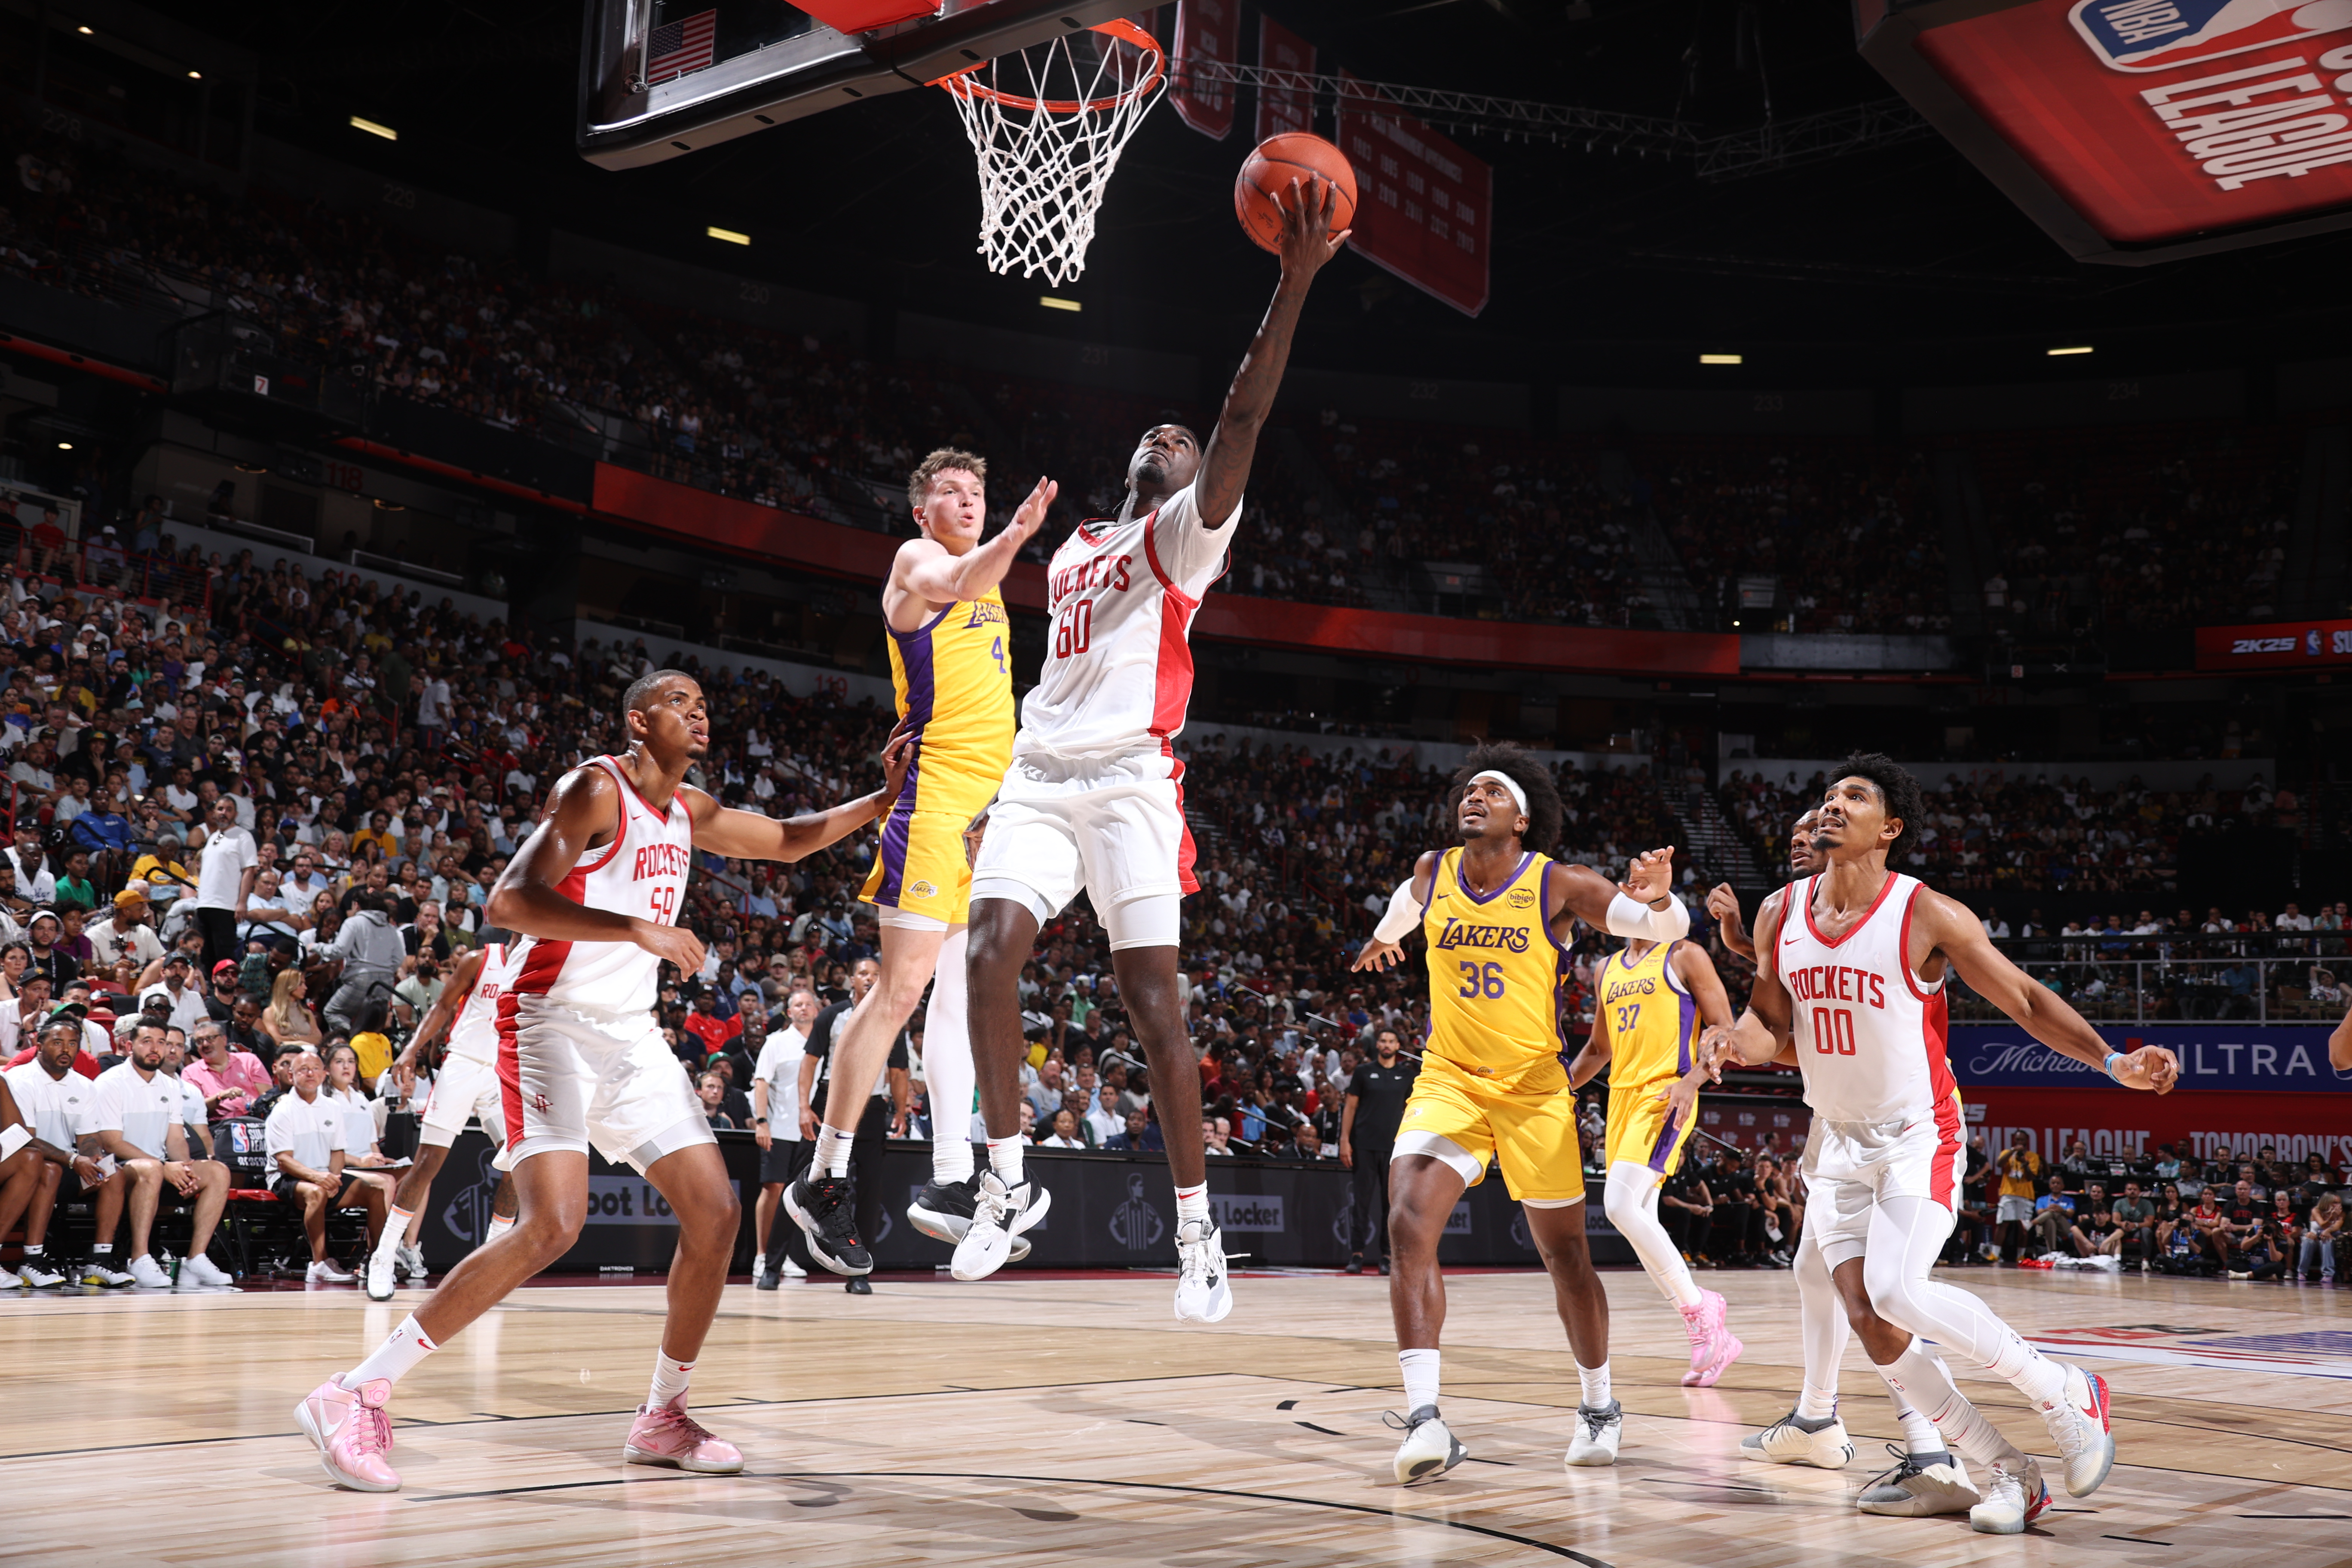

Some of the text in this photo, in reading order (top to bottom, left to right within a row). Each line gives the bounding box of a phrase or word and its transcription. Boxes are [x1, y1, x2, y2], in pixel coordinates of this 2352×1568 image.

[2100, 0, 2189, 44] NBA
[42, 107, 82, 141] 228
[2139, 56, 2352, 191] LEAGUE
[382, 183, 416, 209] 229
[739, 282, 769, 305] 230
[1082, 346, 1109, 365] 231
[257, 378, 266, 392] 7
[1410, 381, 1439, 400] 232
[2107, 382, 2140, 401] 234
[1753, 394, 1784, 412] 233
[327, 462, 364, 491] 118
[1056, 599, 1093, 659] 60
[991, 636, 1007, 674] 4
[2231, 636, 2297, 654] 2K25
[911, 884, 936, 896] LAKERS
[1510, 893, 1533, 903] bibigo
[650, 887, 674, 925] 59
[1436, 917, 1530, 953] LAKERS
[1459, 961, 1504, 999] 36
[1606, 977, 1656, 1005] LAKERS
[1788, 965, 1884, 1010] ROCKETS
[1617, 1004, 1640, 1032] 37
[1813, 1007, 1856, 1056] 00
[588, 1186, 633, 1216] oot
[1224, 1200, 1279, 1226] Locker
